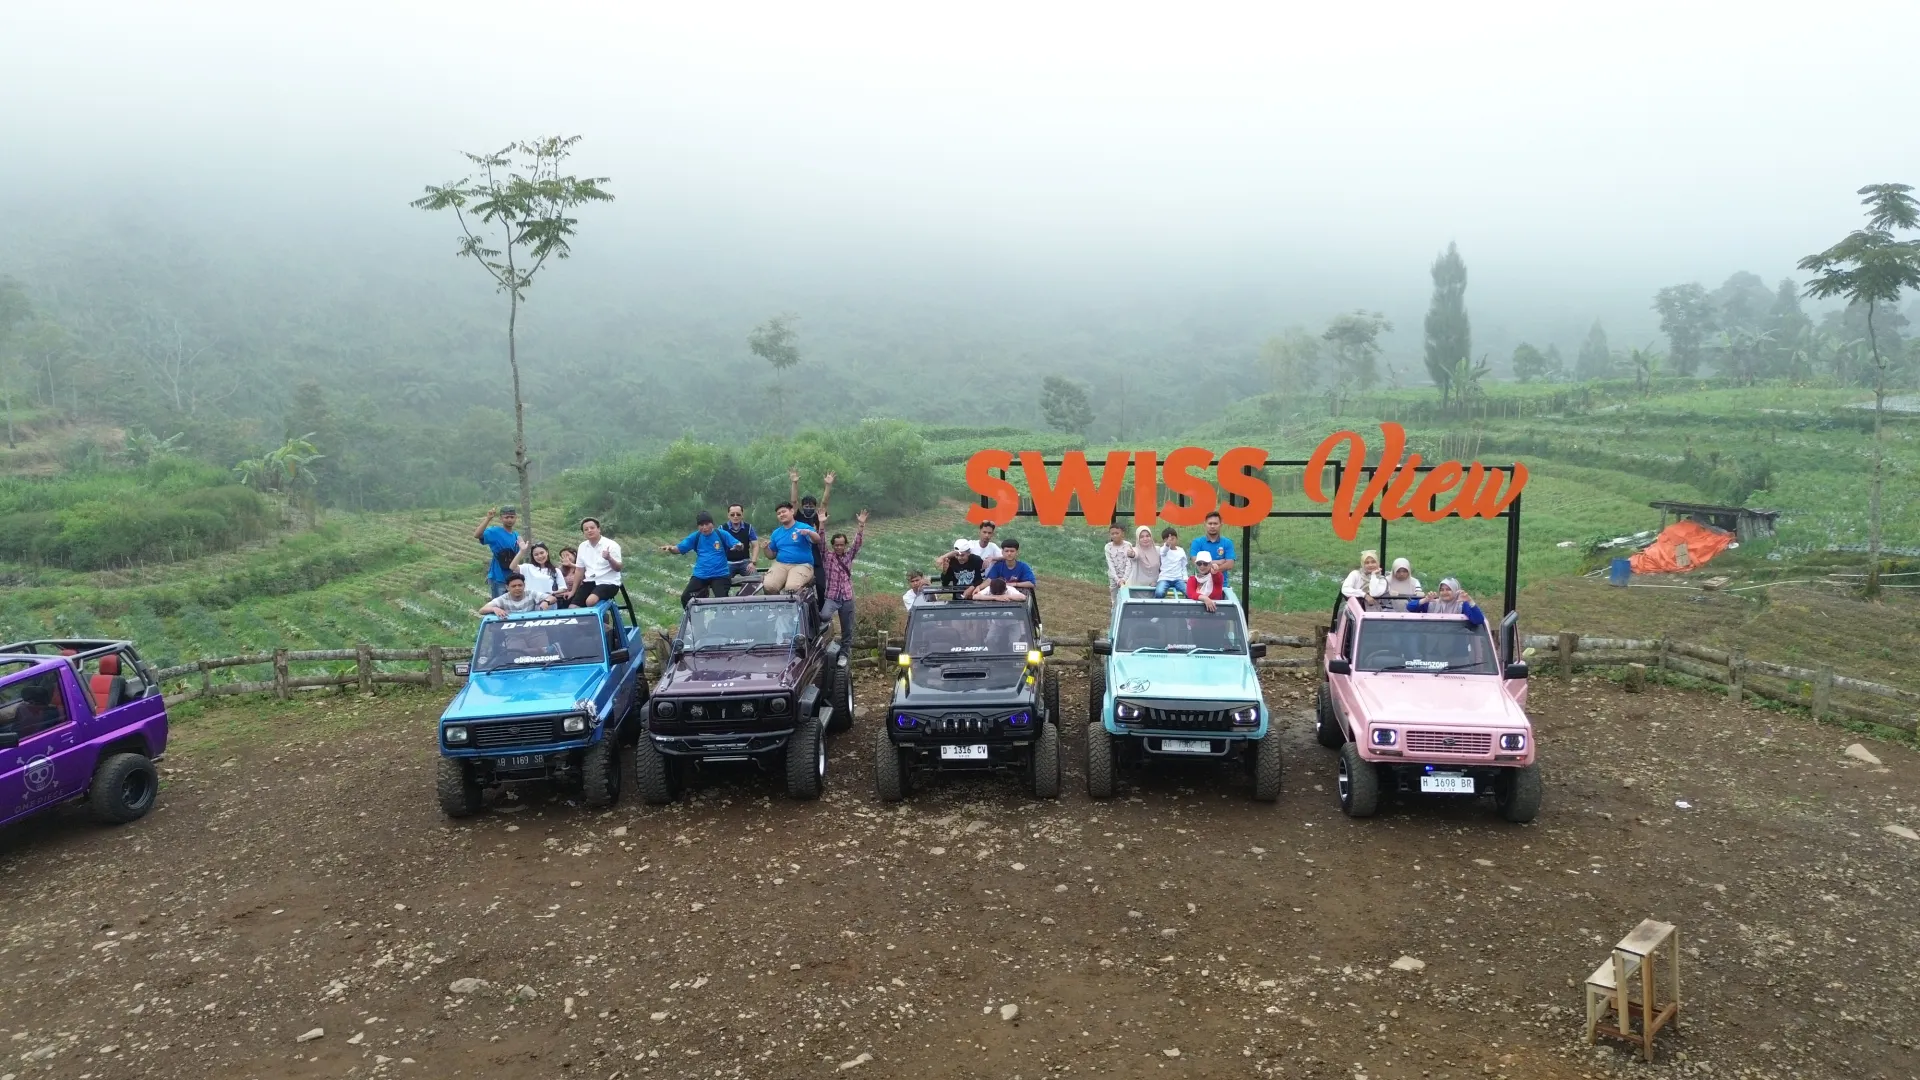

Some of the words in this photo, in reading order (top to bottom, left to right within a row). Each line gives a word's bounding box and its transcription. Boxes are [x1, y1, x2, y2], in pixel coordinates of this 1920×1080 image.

[965, 447, 1273, 526] SWISS
[1303, 422, 1529, 541] View
[501, 618, 578, 630] D-MOFA
[942, 746, 948, 755] D
[953, 745, 972, 755] 1316
[977, 745, 986, 754] CV
[512, 755, 529, 765] 1169
[1423, 778, 1429, 787] H
[1434, 778, 1456, 788] 1698
[1461, 778, 1472, 788] BR
